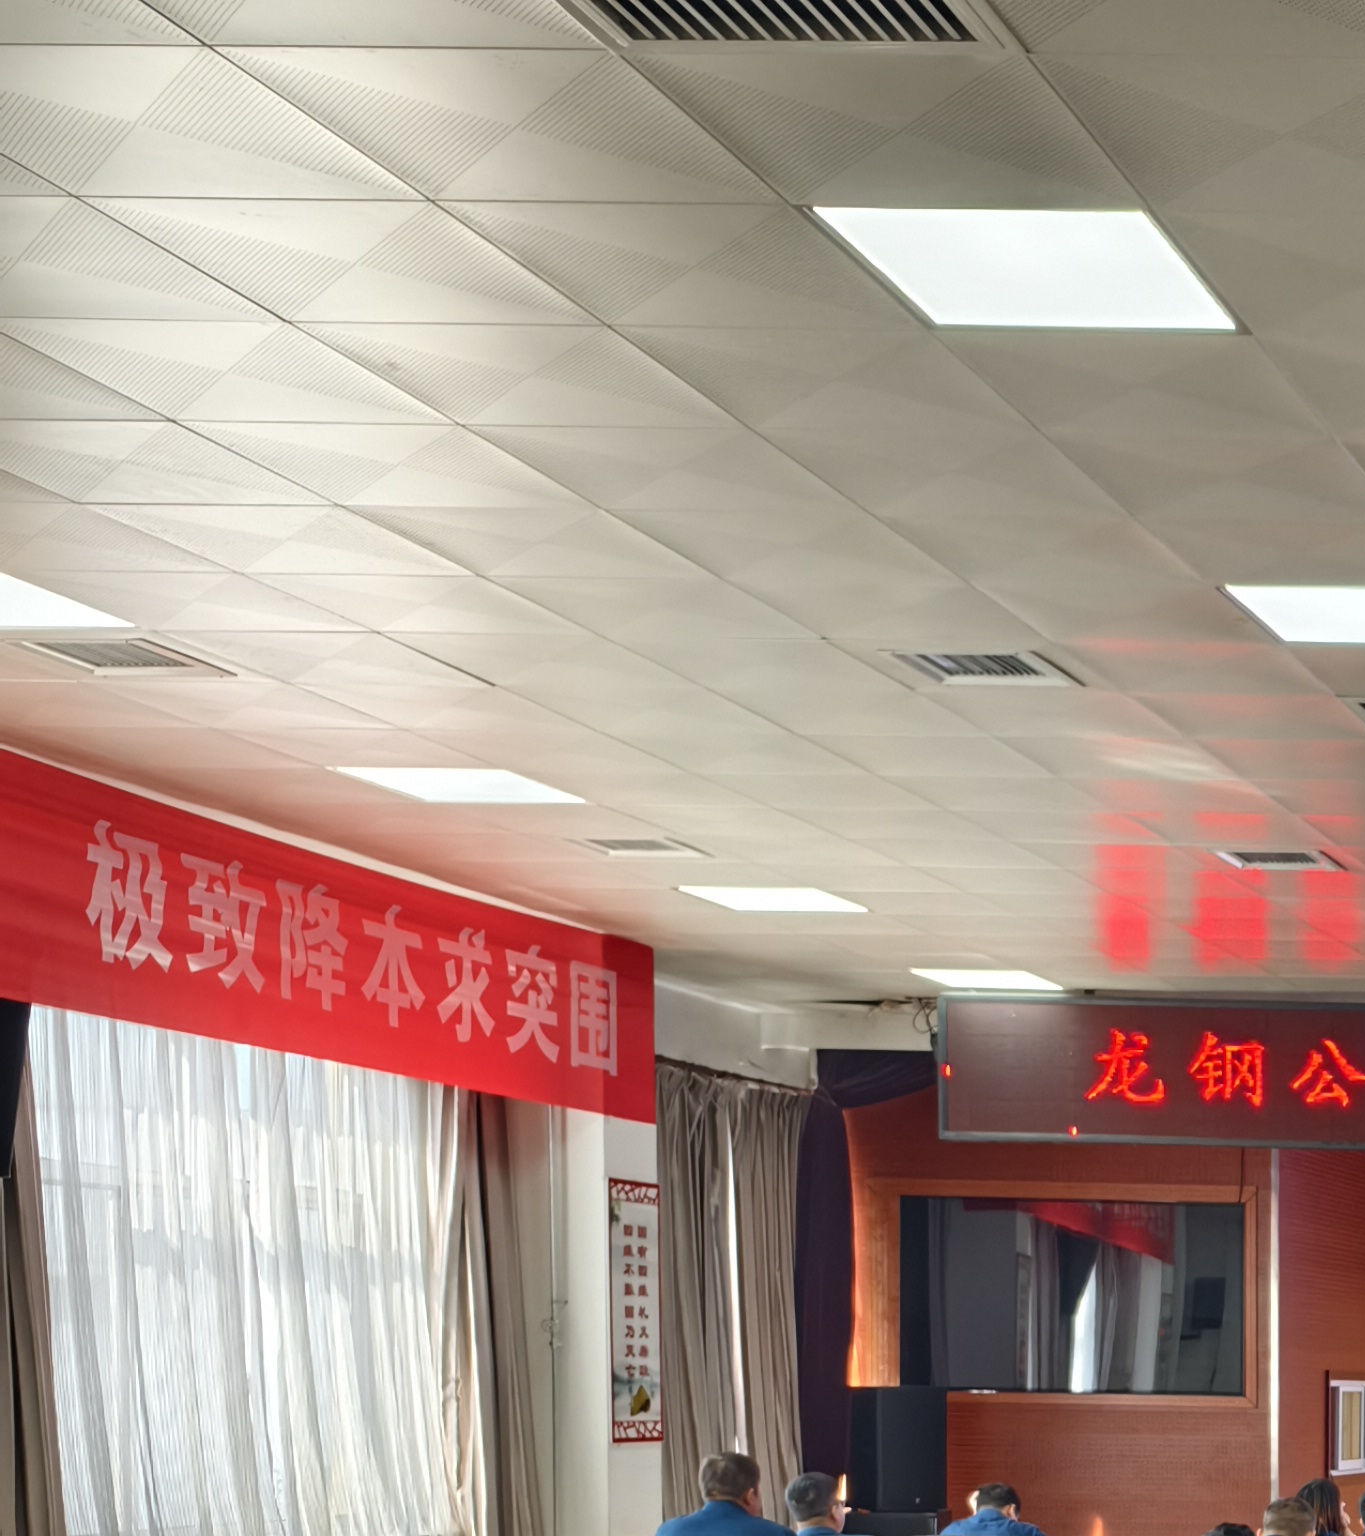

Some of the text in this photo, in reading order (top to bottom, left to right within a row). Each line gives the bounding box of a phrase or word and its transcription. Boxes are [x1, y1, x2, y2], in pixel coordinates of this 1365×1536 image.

[86, 819, 619, 1077] 极致降本求突围
